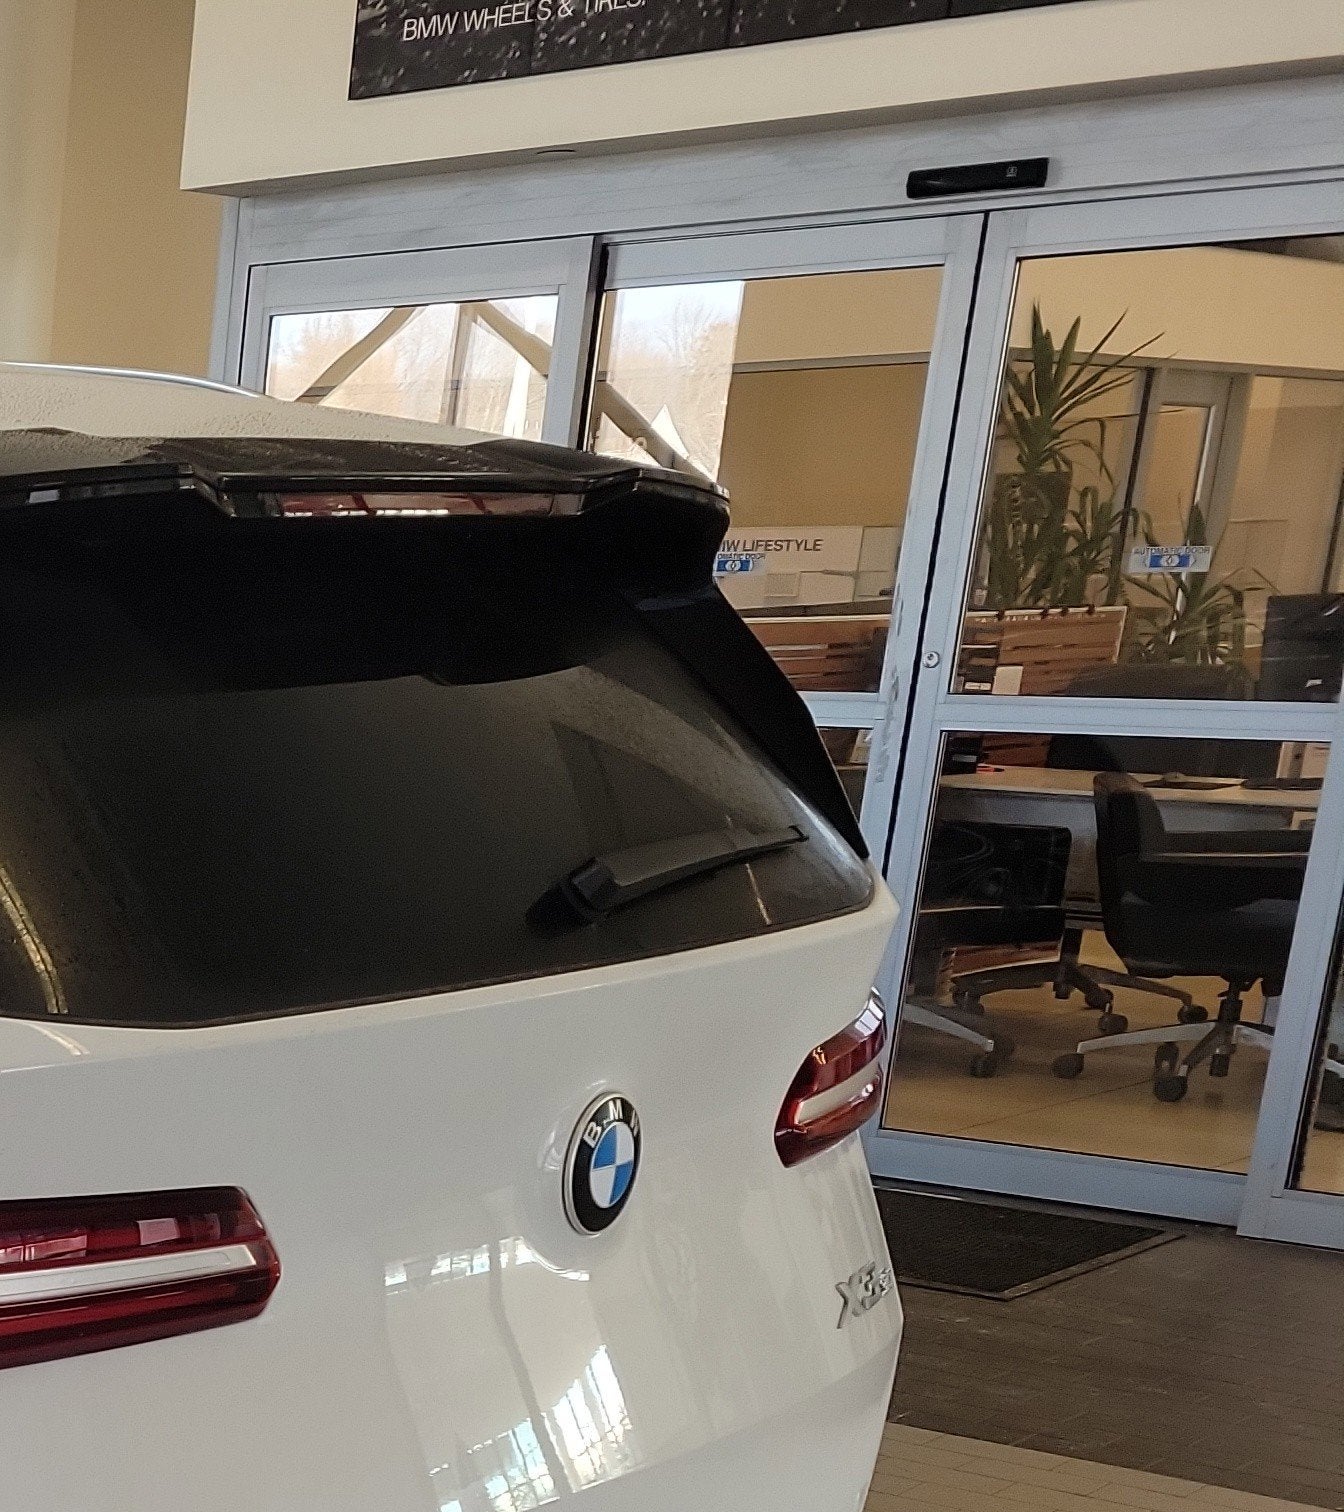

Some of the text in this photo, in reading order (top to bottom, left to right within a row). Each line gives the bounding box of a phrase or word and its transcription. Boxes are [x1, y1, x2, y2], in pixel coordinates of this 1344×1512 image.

[402, 12, 460, 42] BMW
[463, 0, 553, 33] WHEELS
[557, 0, 574, 18] &
[743, 539, 825, 552] LIFESTYLE
[582, 1099, 640, 1149] BMW
